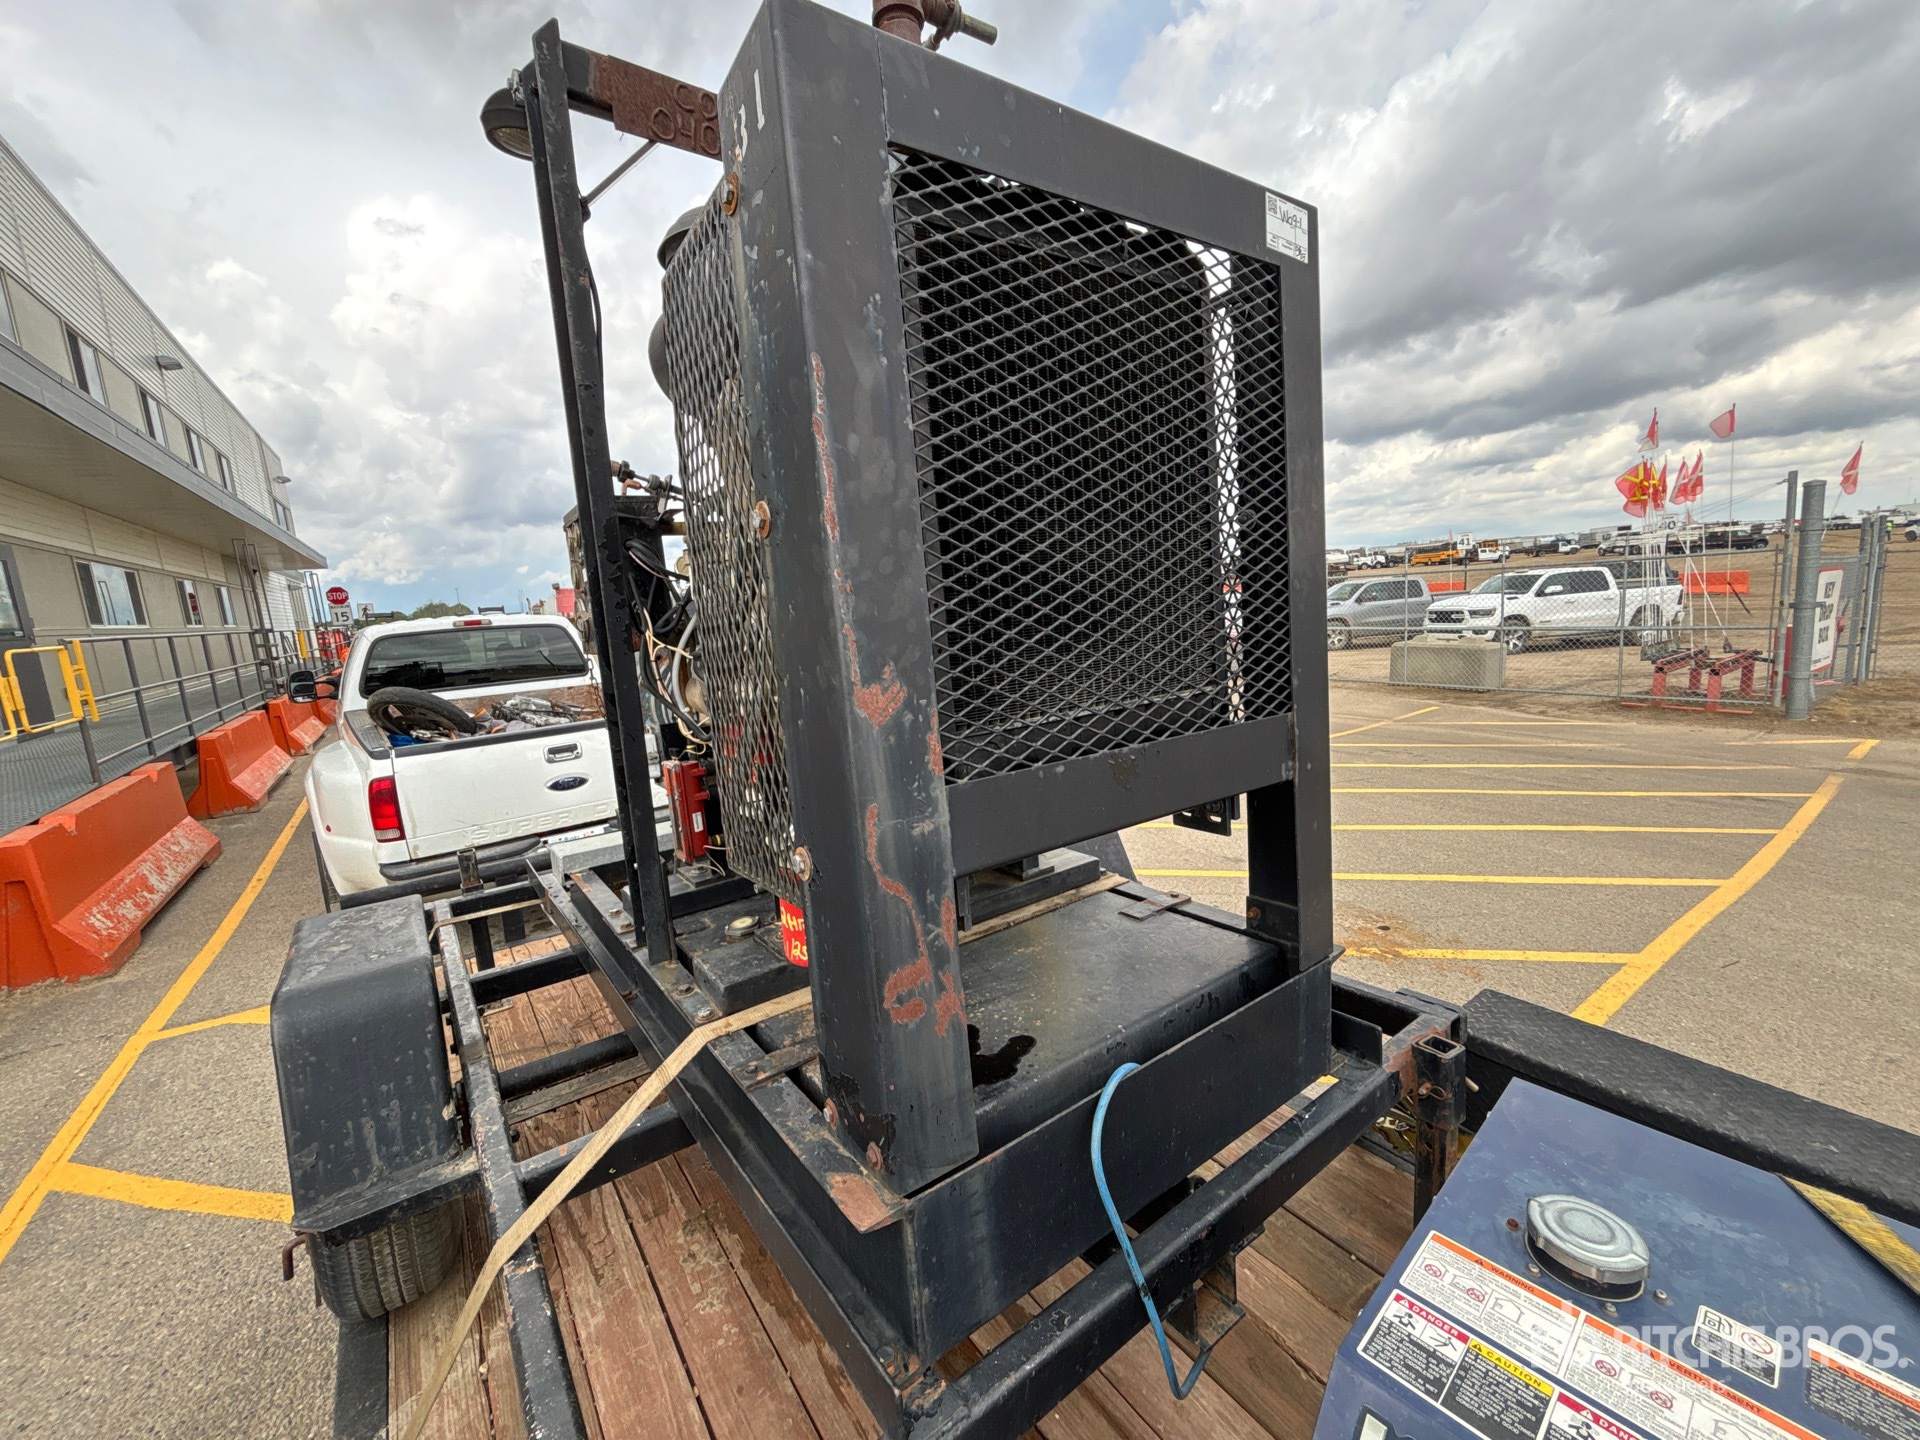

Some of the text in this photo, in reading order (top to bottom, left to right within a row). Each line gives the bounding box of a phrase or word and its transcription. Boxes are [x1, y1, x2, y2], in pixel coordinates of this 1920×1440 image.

[1458, 538, 1471, 546] 41
[327, 591, 348, 600] STOP
[1823, 581, 1836, 599] KEY
[334, 611, 350, 623] 15
[557, 778, 581, 789] Ford
[471, 810, 574, 842] SUPER
[1489, 1265, 1535, 1293] WARNING
[1411, 1304, 1458, 1337] DANGER
[1485, 1349, 1541, 1387] CAUTION
